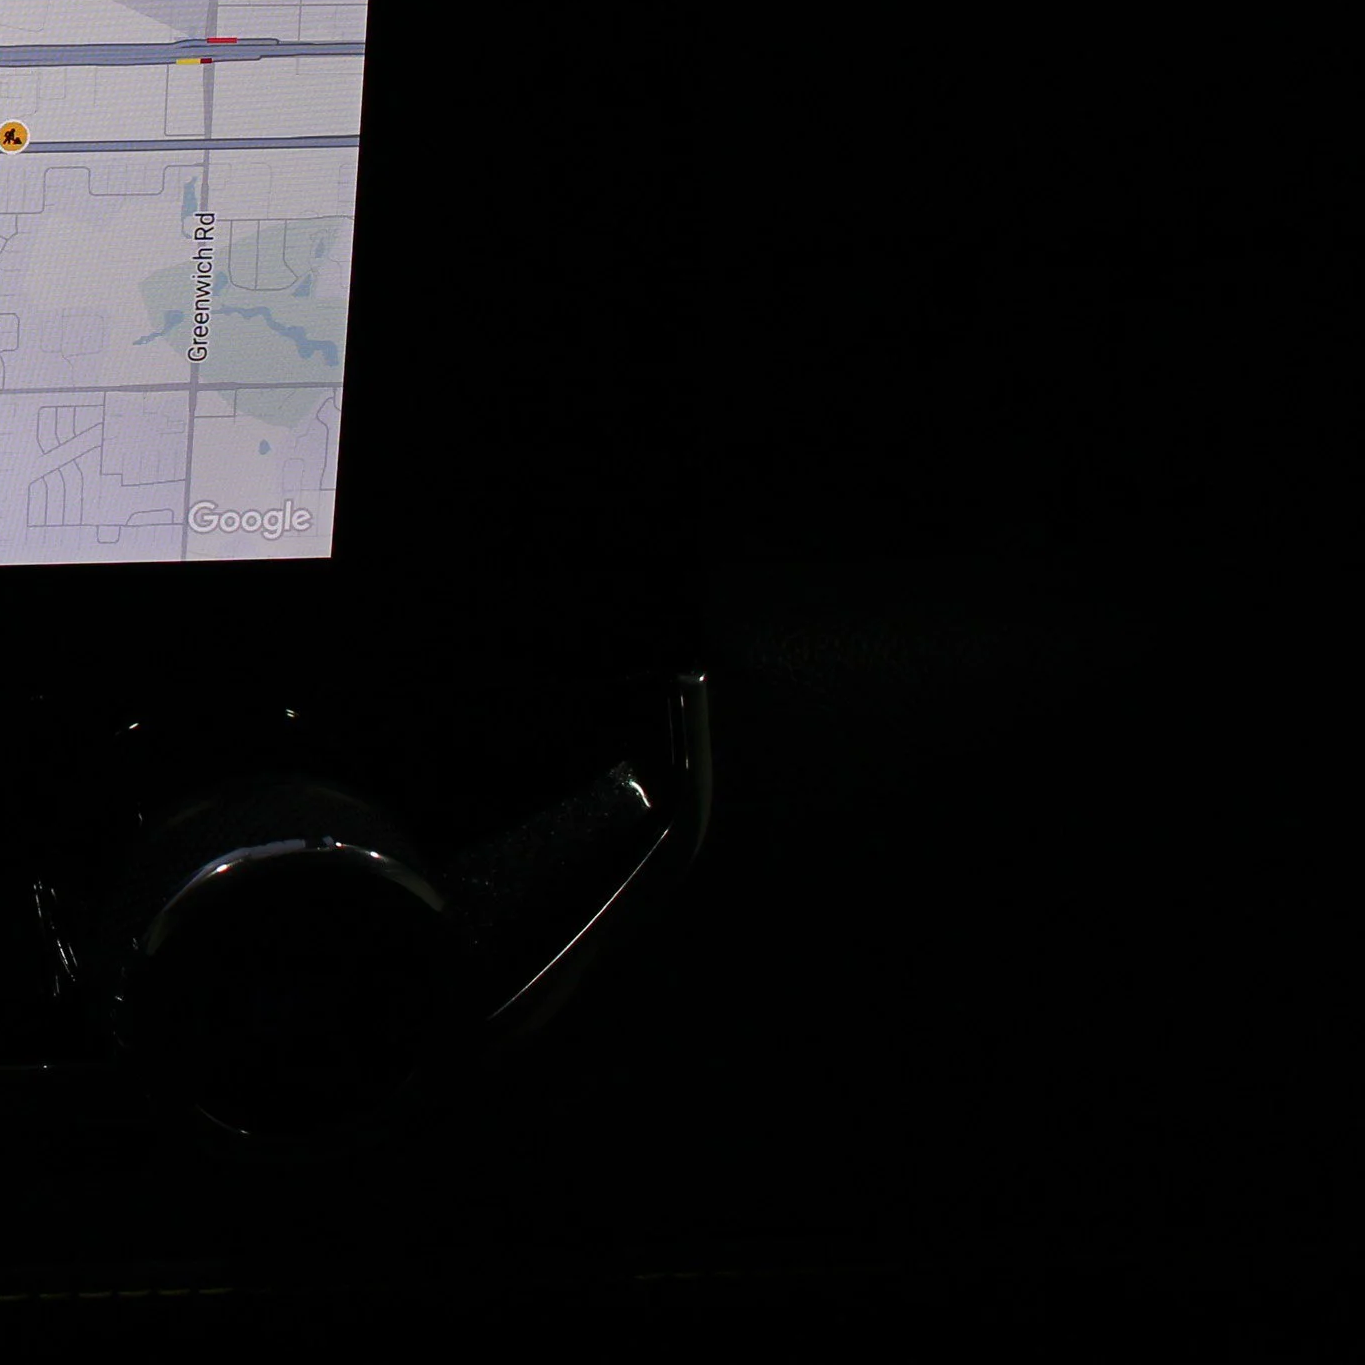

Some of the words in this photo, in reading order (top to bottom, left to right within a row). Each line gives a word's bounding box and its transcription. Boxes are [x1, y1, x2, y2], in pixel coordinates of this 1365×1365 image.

[194, 213, 215, 241] Rd
[187, 240, 213, 362] Greenwich
[188, 500, 312, 539] Google
